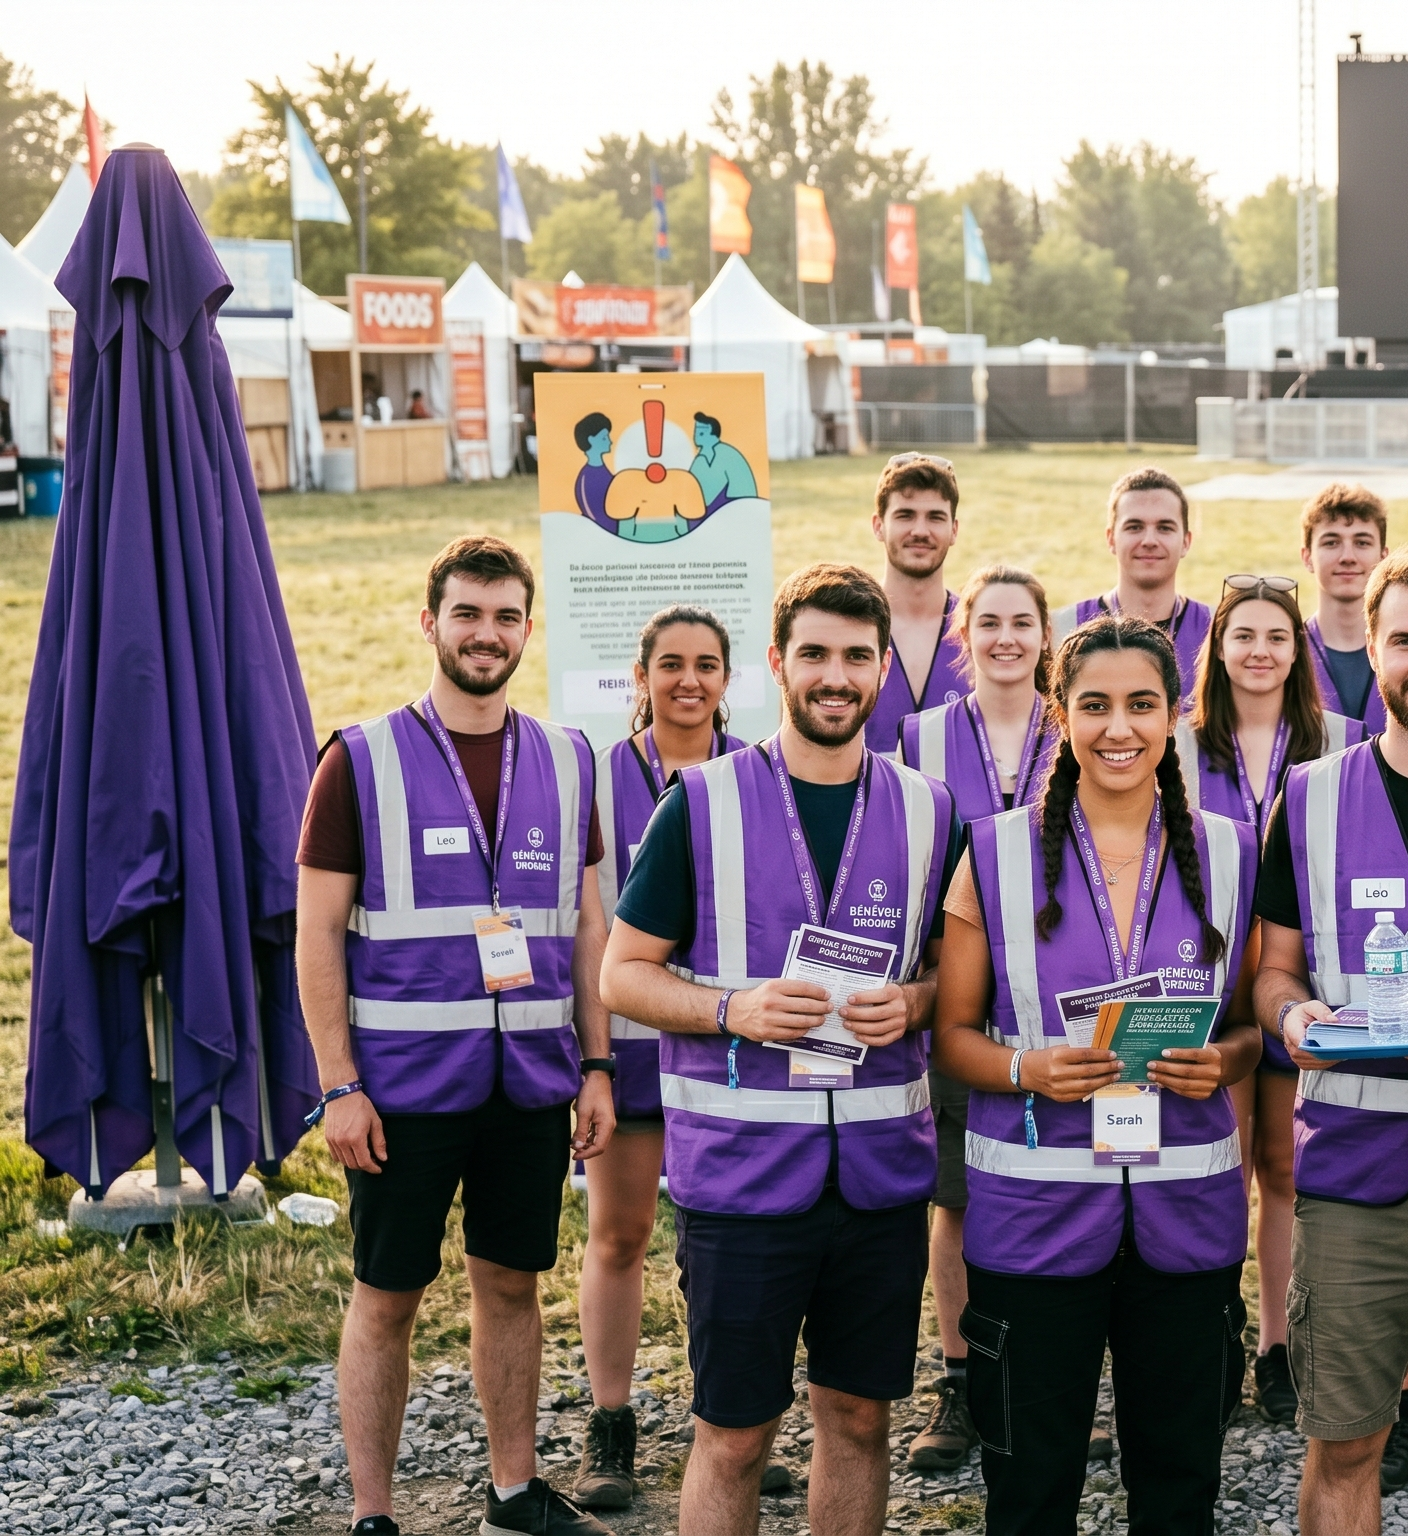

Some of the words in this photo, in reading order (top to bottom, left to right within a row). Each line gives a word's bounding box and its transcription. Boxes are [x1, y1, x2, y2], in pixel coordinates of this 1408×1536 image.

[363, 291, 433, 329] FOODS
[436, 836, 456, 846] Leo
[1365, 888, 1389, 898] Leo
[1107, 1114, 1143, 1126] Sarah
